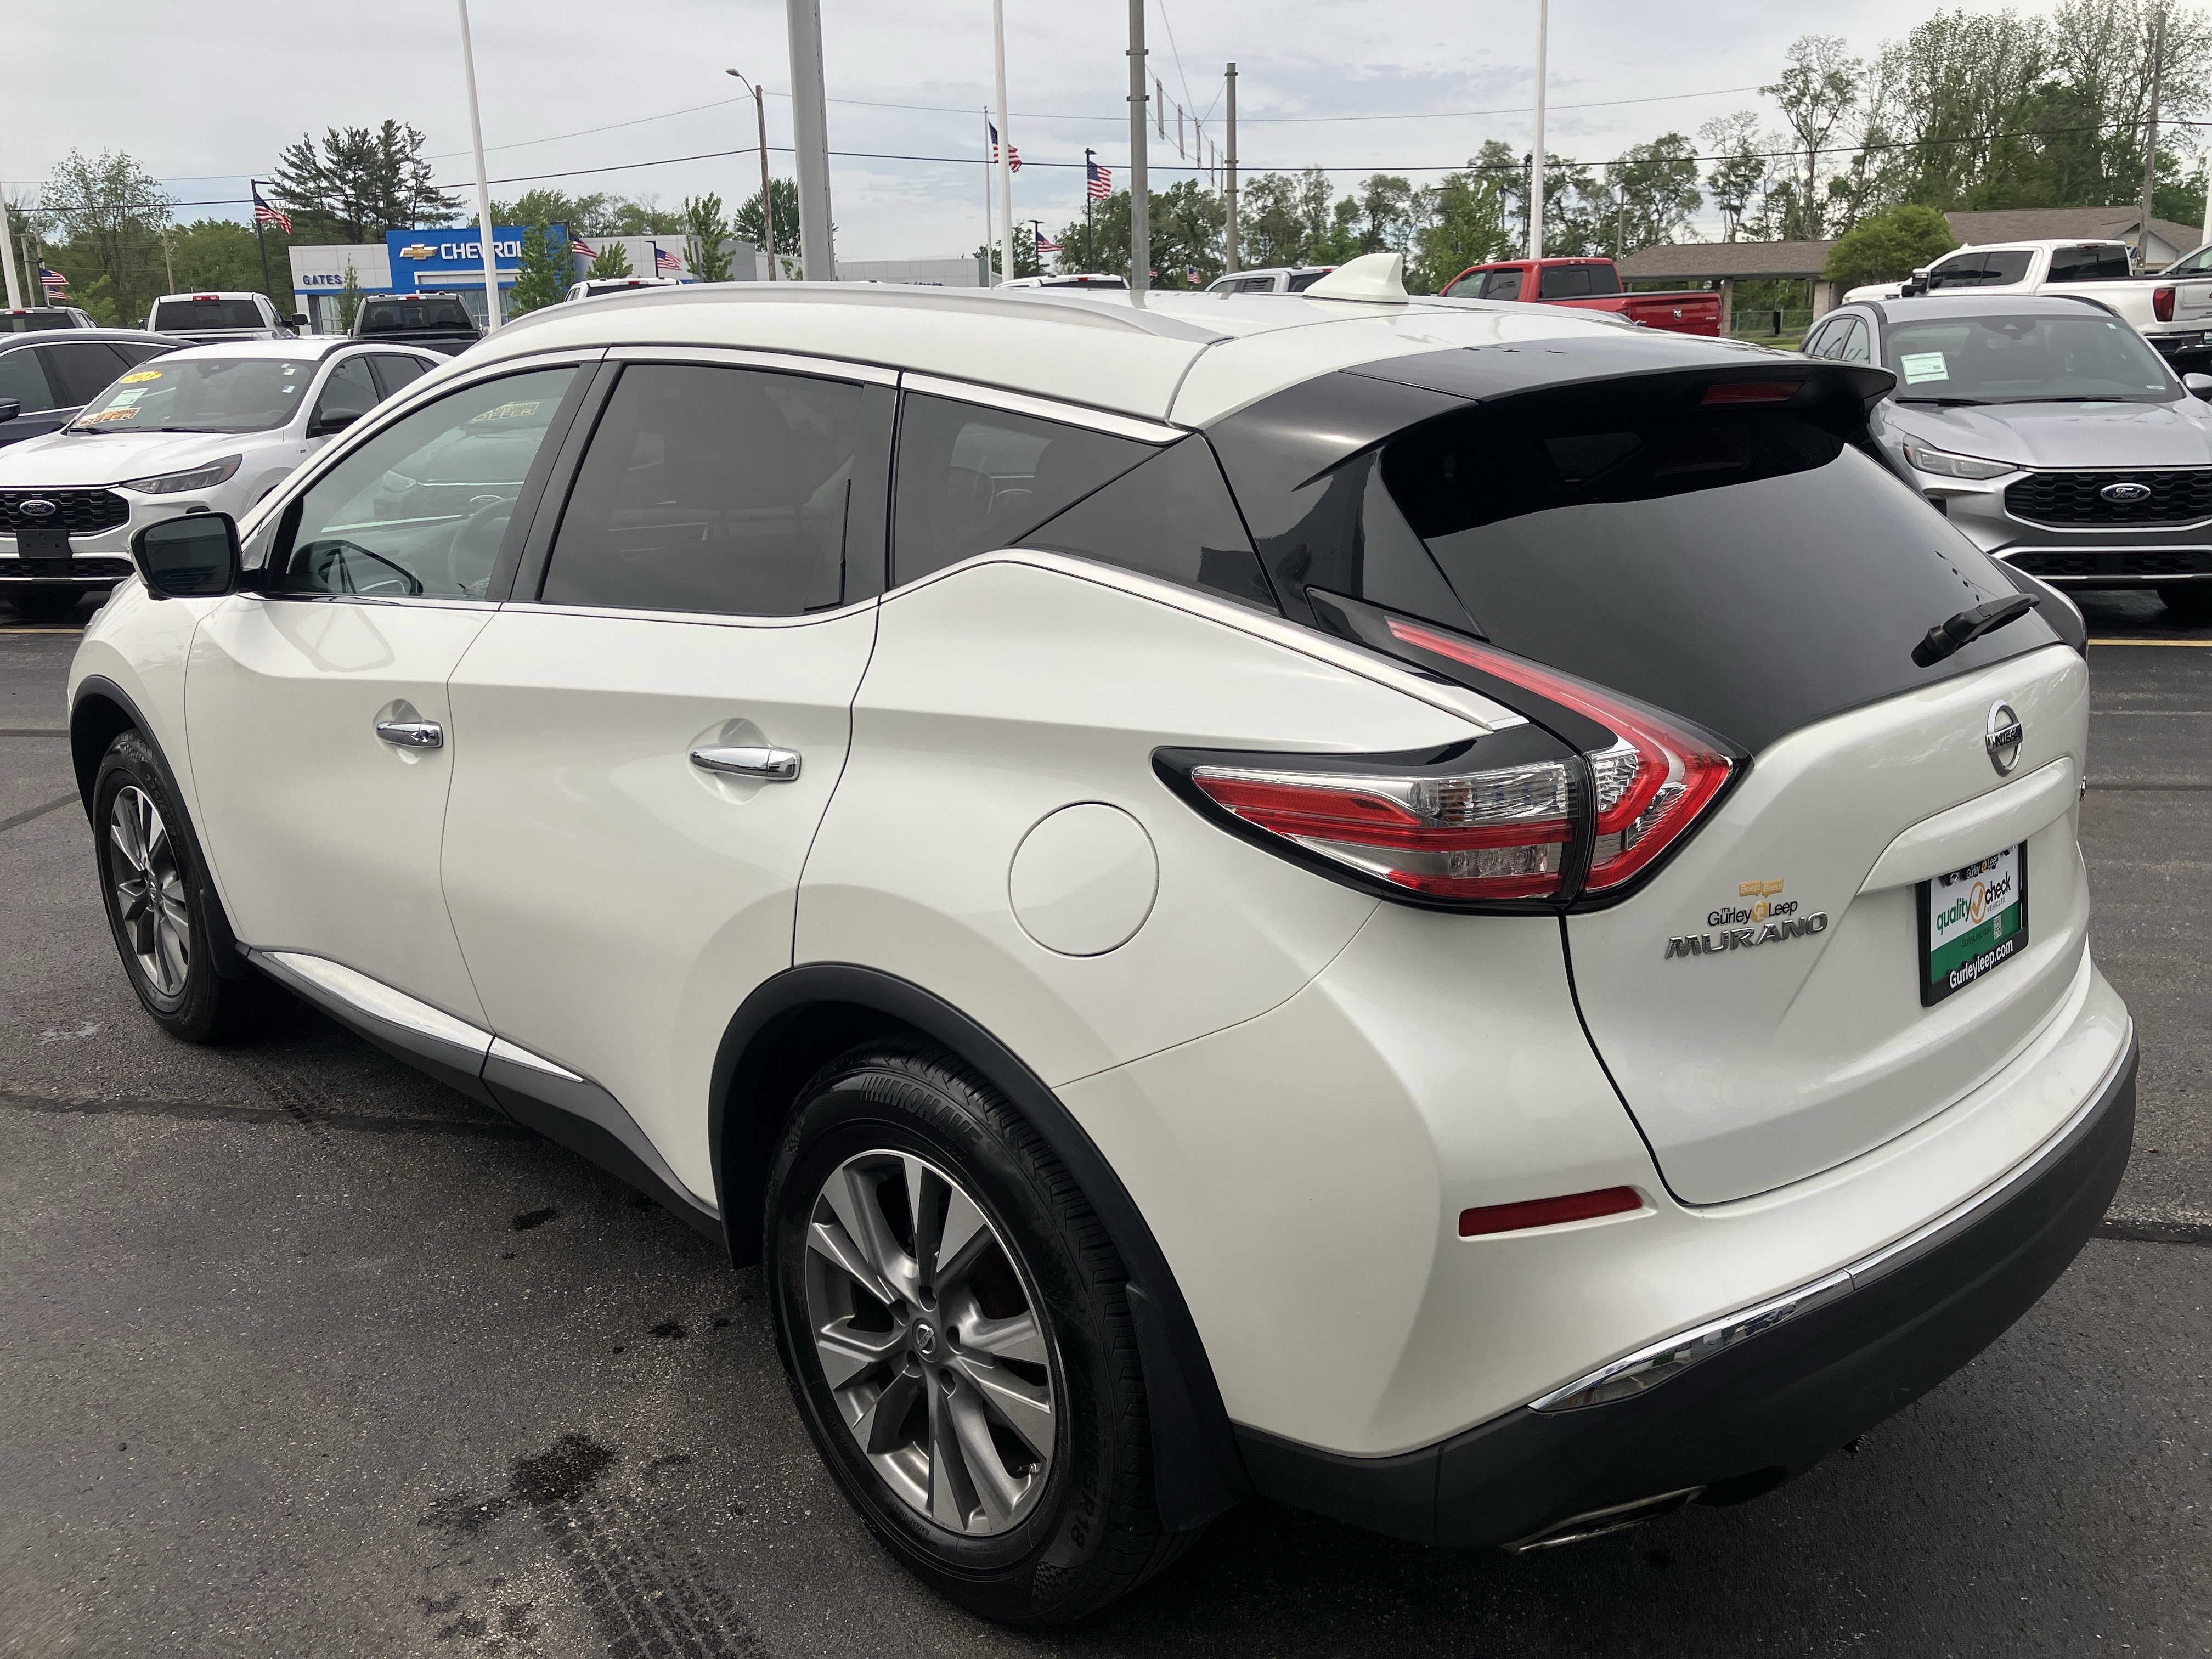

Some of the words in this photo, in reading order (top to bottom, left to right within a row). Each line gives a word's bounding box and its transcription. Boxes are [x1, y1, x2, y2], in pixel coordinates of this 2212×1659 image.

[440, 241, 522, 259] CHEROL
[302, 274, 342, 285] GATES
[78, 413, 132, 425] OFFER
[1995, 725, 2022, 747] NISS
[1741, 881, 1761, 893] Beep!
[1937, 898, 1972, 935] quality
[1985, 871, 2011, 905] check
[1987, 897, 2005, 913] VEHICLES
[1708, 907, 1752, 926] Gurley
[1769, 901, 1798, 917] Leep
[1664, 911, 1829, 960] MURANO
[1949, 939, 2013, 989] Gurleyleep.com
